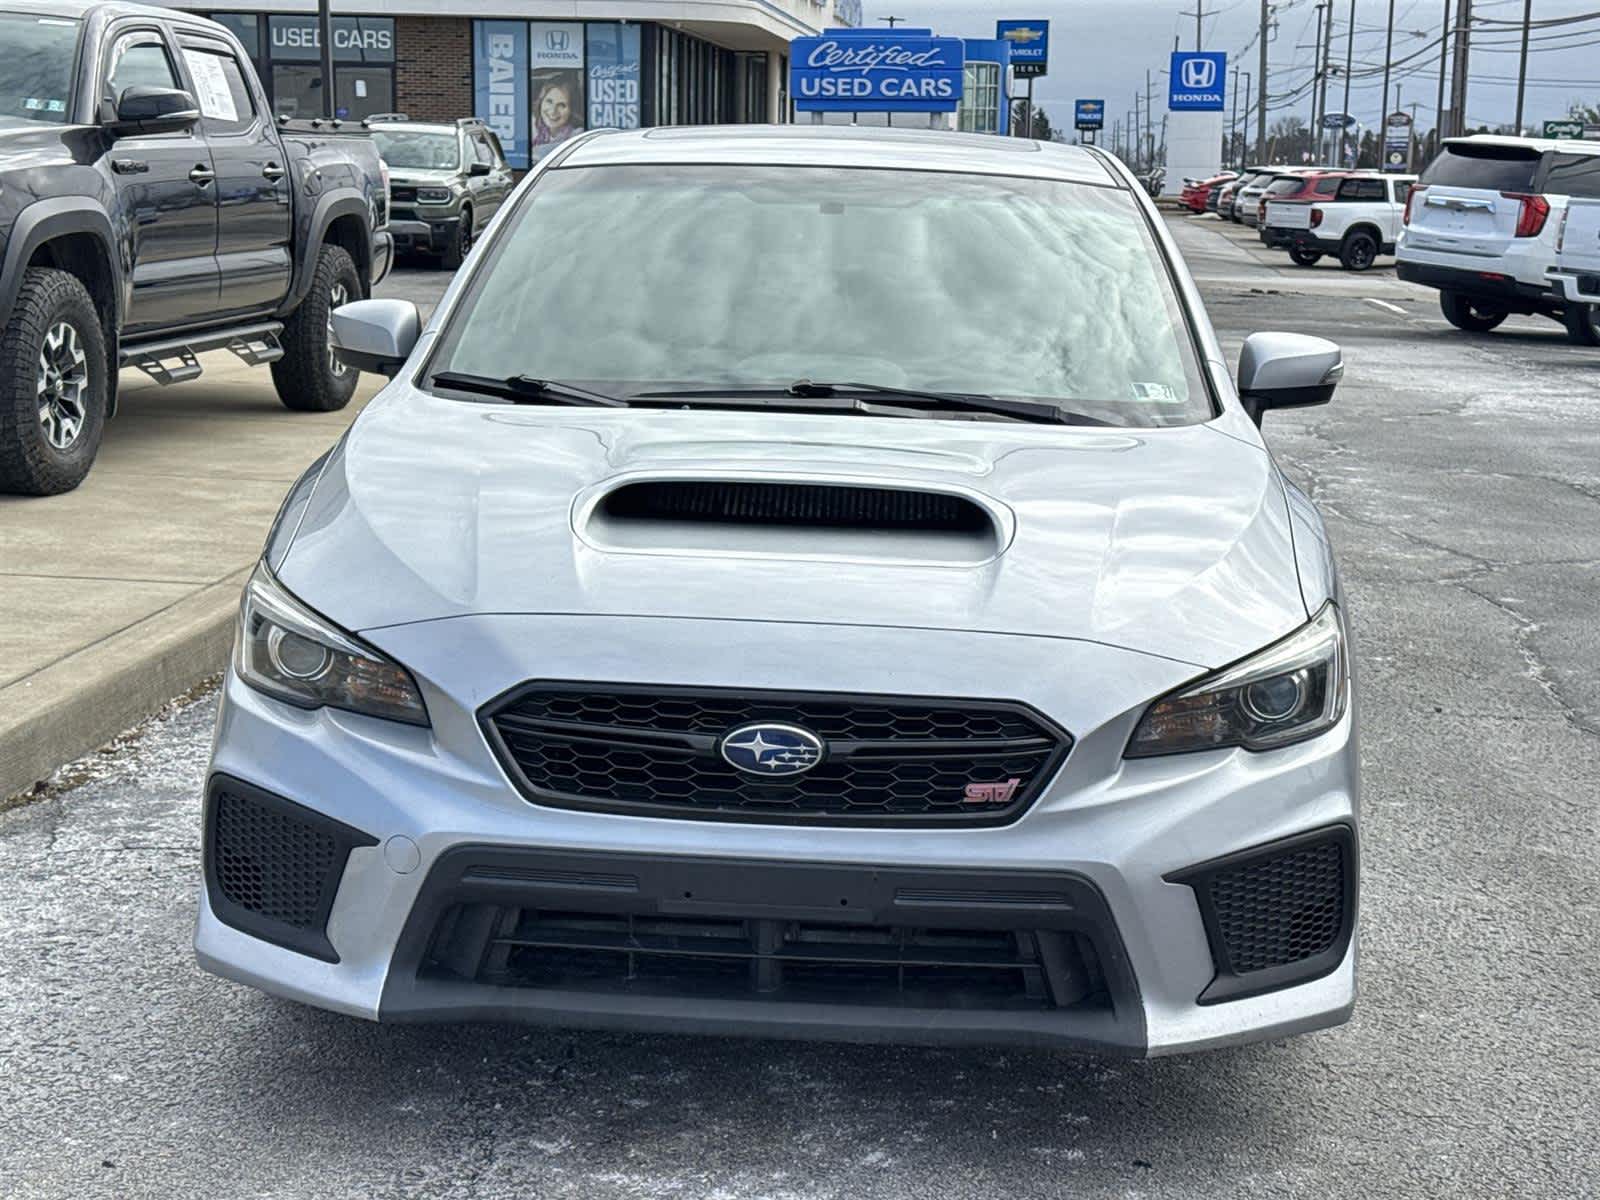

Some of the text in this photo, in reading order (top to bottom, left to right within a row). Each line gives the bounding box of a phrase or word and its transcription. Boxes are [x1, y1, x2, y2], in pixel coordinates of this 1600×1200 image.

[334, 29, 392, 49] CARS
[537, 52, 578, 60] HONDA
[807, 41, 945, 75] Certified
[590, 79, 638, 103] USED
[801, 77, 953, 97] USED CARS
[1172, 94, 1222, 103] HONDA
[591, 103, 638, 129] CARS
